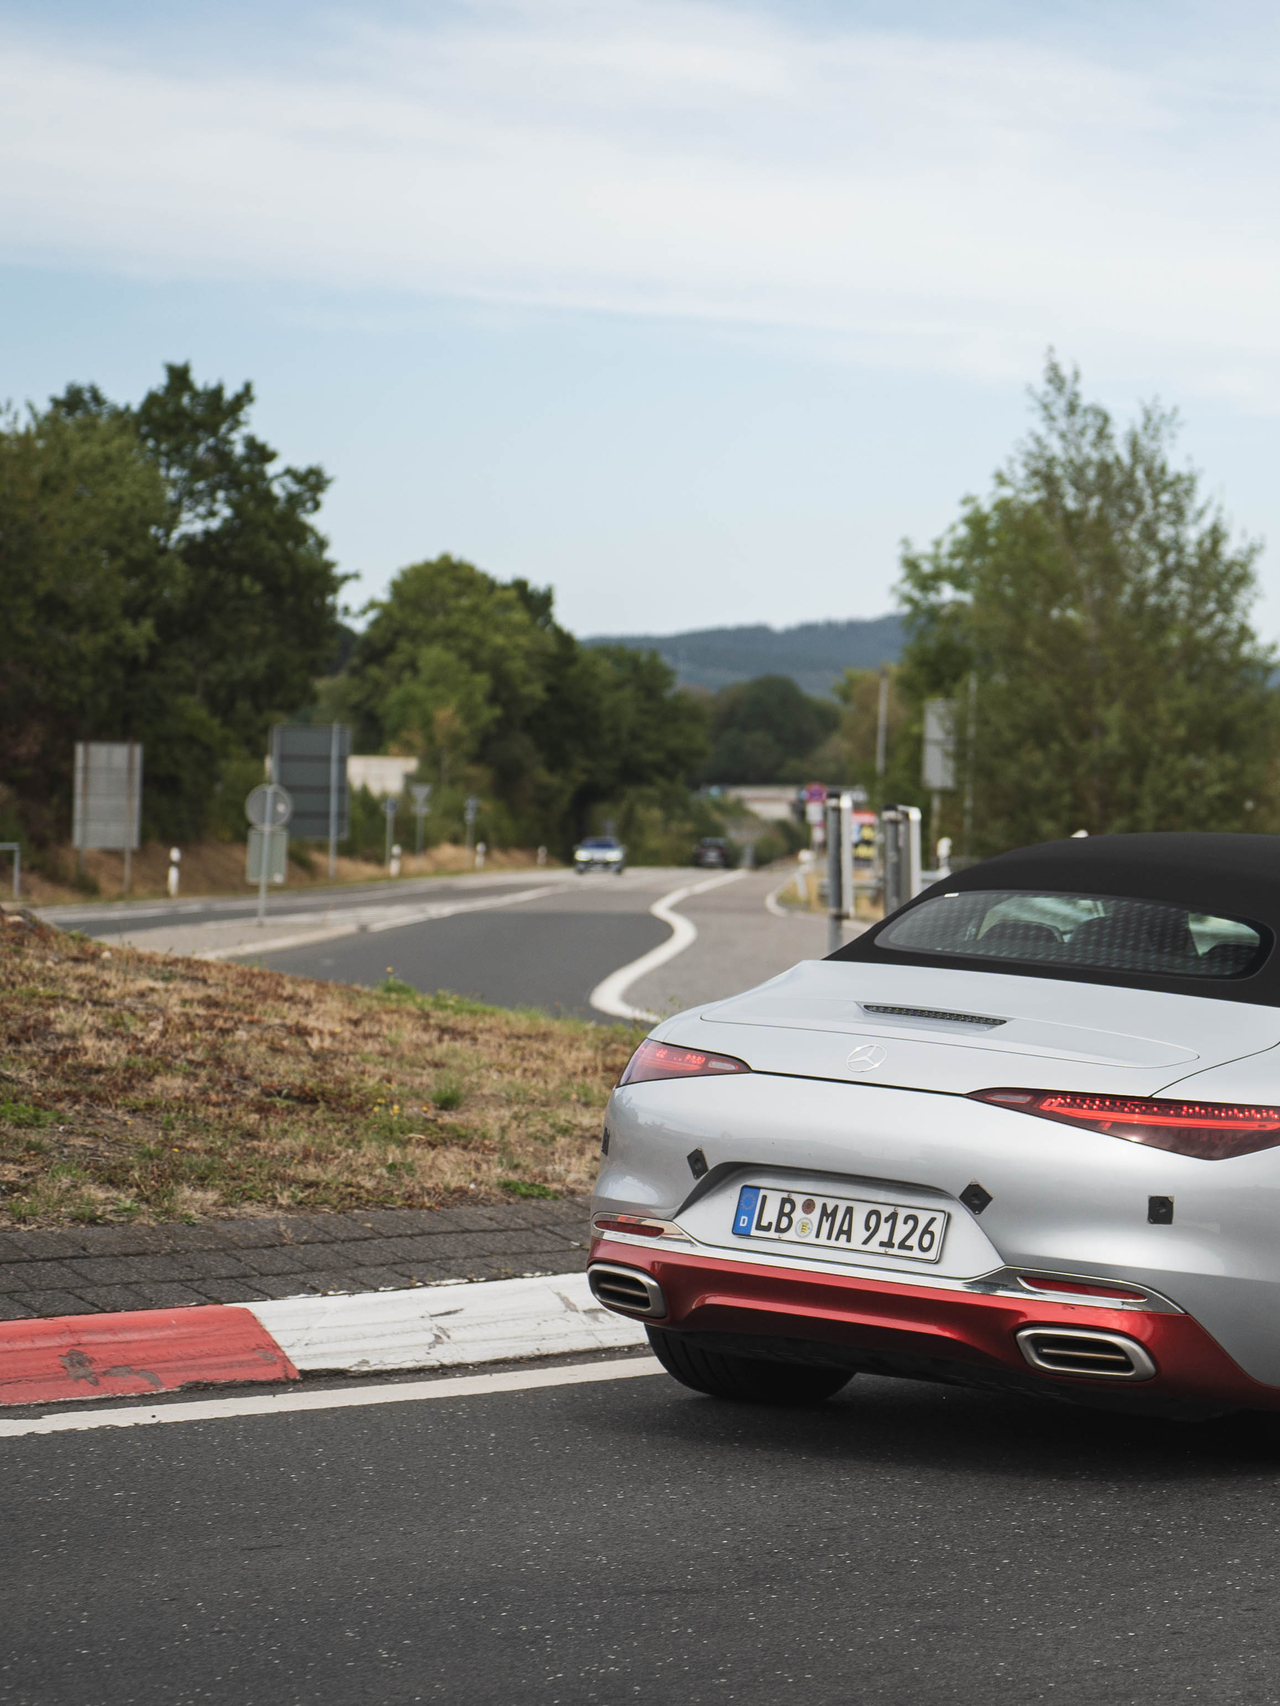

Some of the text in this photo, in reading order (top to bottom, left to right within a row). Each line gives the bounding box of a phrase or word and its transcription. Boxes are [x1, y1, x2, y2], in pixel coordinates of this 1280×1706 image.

[739, 1195, 937, 1253] D LB MA 9126
